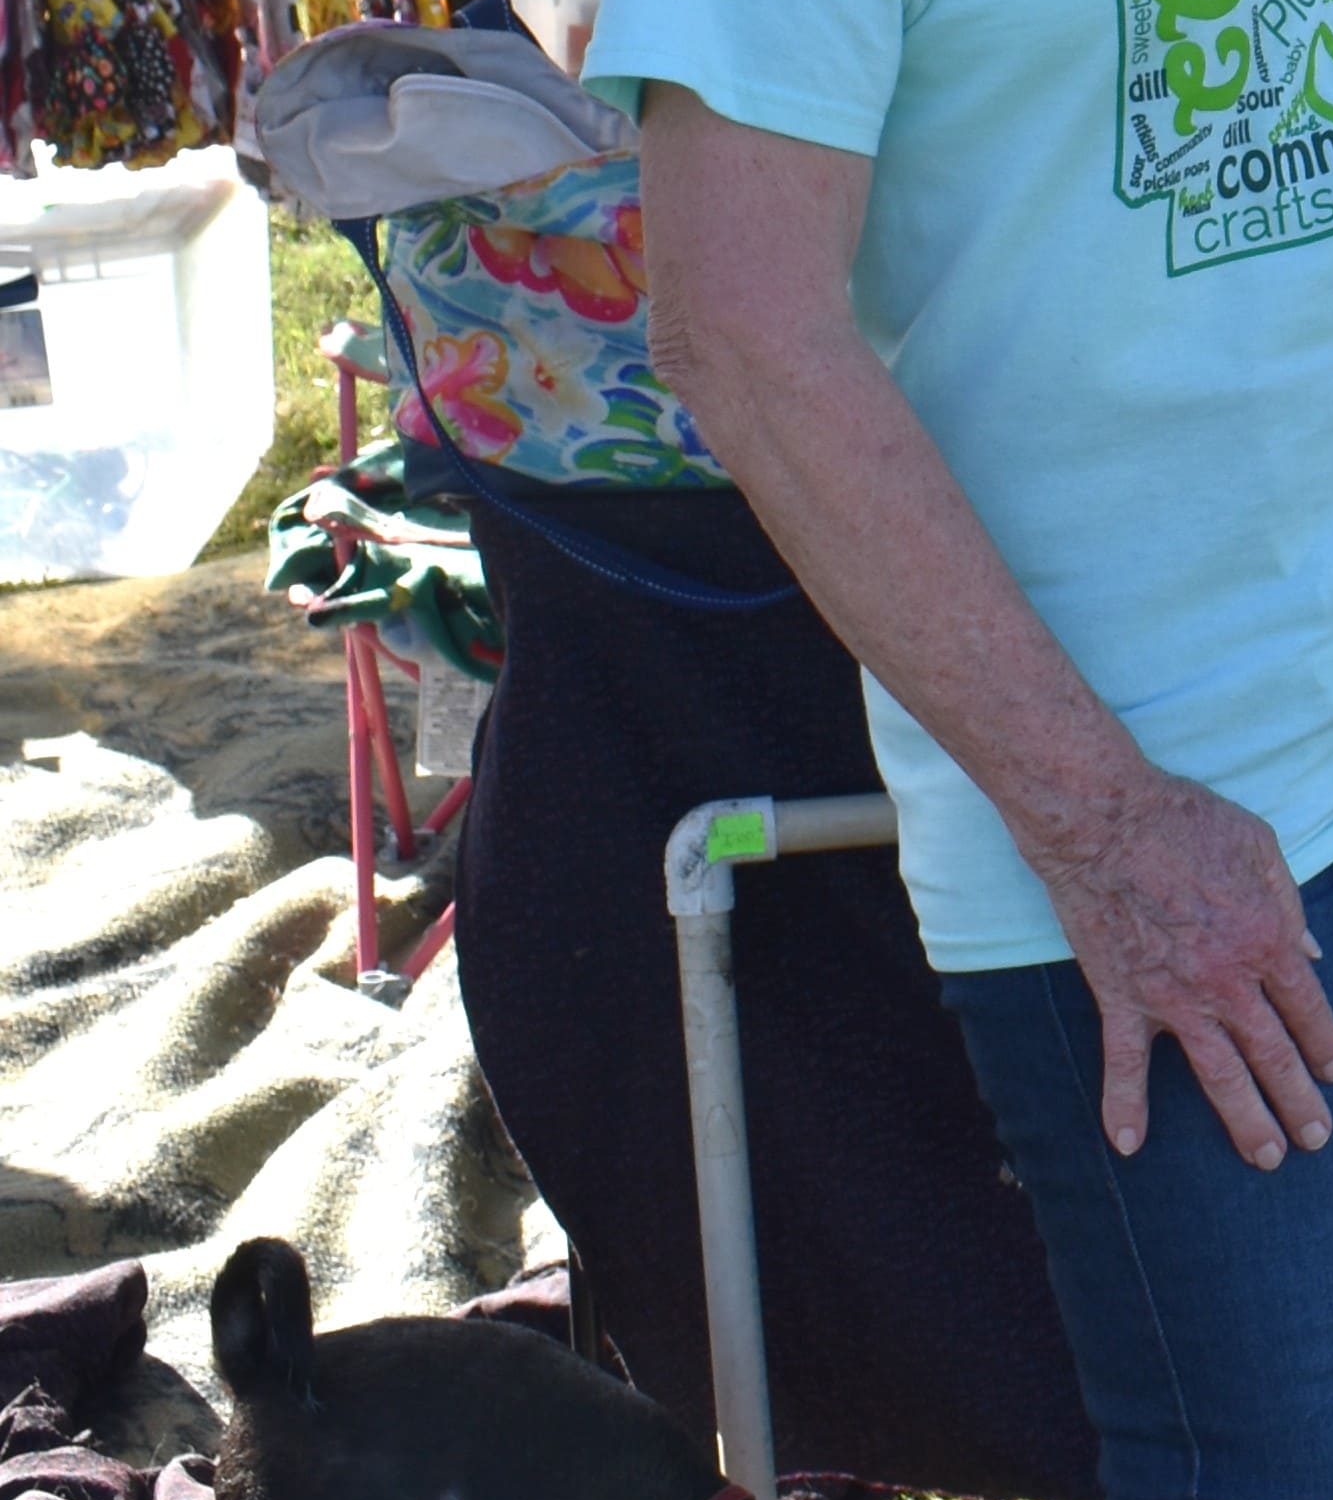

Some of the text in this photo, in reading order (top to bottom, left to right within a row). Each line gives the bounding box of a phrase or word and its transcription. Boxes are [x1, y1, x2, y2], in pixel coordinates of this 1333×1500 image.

[1280, 38, 1307, 86] baby
[1128, 67, 1168, 103] dill
[1236, 86, 1285, 115] sour
[1130, 114, 1159, 163] Atkins
[1155, 123, 1213, 173] community
[1222, 117, 1252, 149] dill
